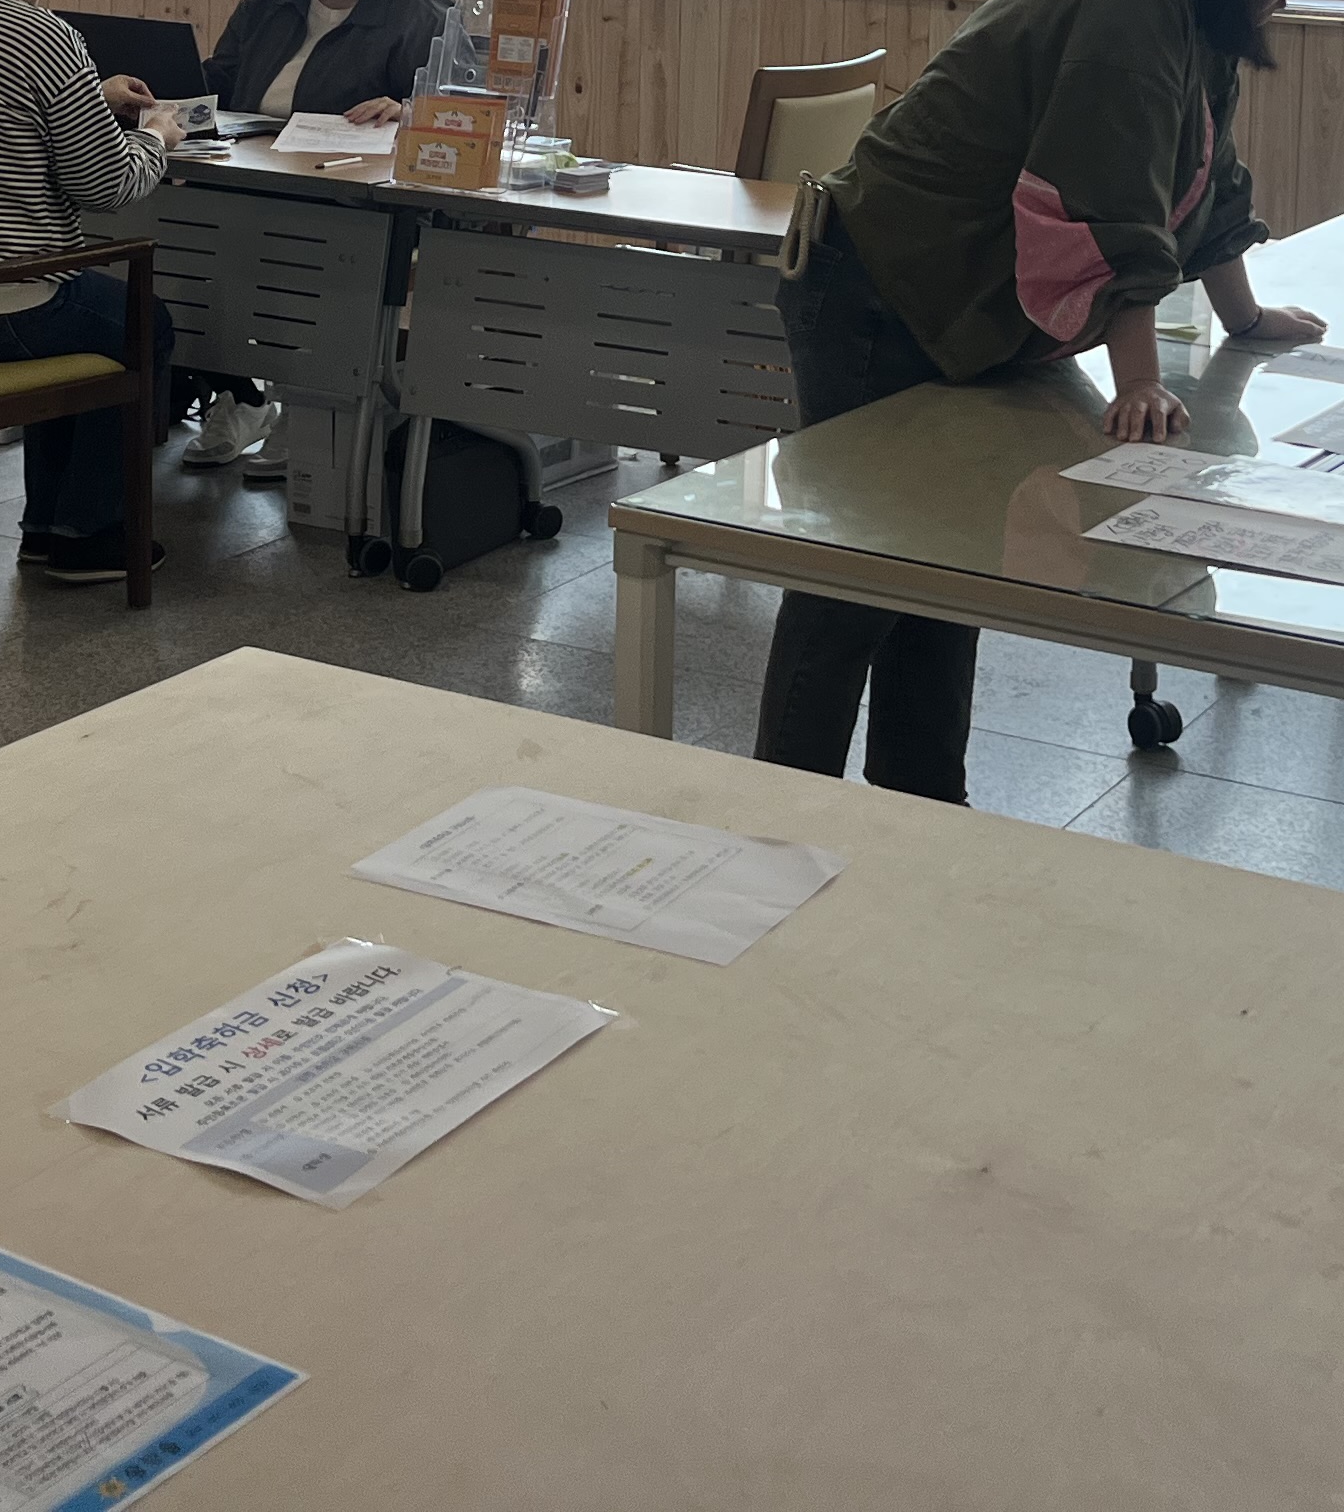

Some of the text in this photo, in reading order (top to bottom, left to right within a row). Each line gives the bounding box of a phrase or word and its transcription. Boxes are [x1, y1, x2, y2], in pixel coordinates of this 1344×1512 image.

[135, 1096, 181, 1122] 서류
[174, 1074, 222, 1099] 발급
[218, 1059, 246, 1076] 시
[241, 1028, 300, 1061] 상세로
[291, 1005, 337, 1029] 발급
[328, 965, 403, 1007] 바랍니다.
[140, 1010, 270, 1085] <입학축하금
[267, 973, 330, 1009] 신청>
